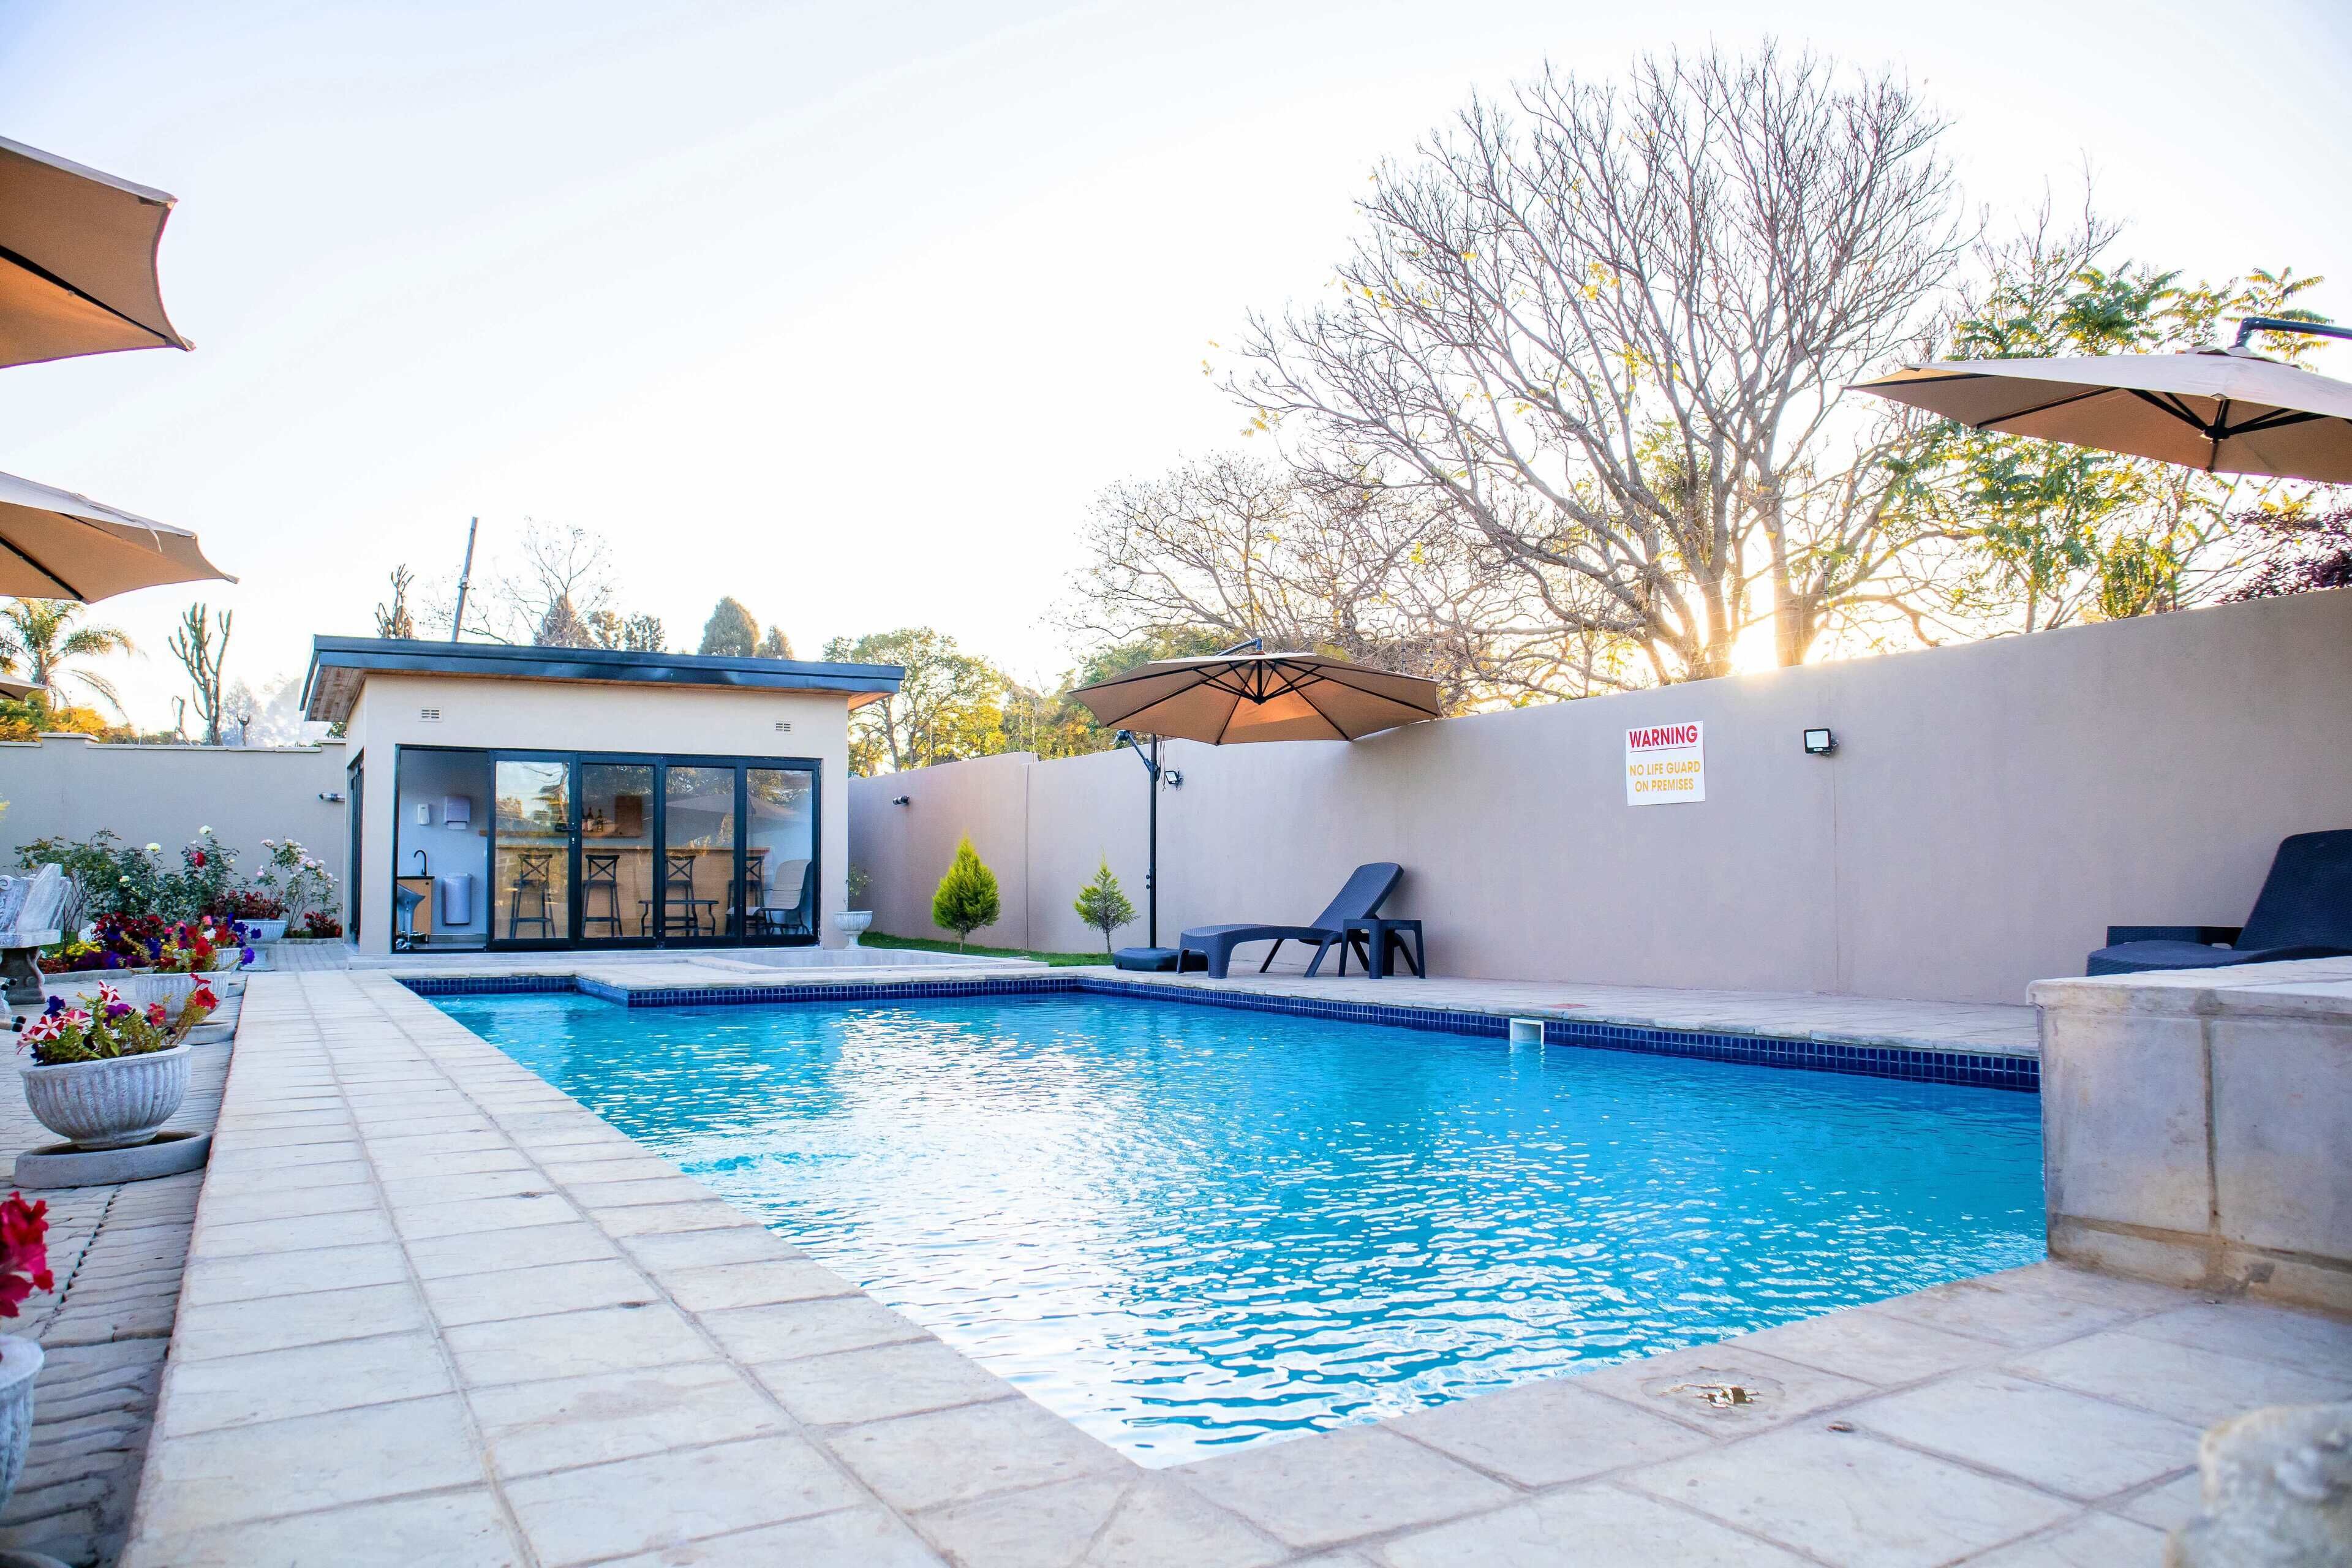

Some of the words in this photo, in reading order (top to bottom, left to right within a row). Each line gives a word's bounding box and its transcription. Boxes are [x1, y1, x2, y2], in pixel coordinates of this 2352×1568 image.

[1629, 725, 1698, 748] WARNING
[1629, 764, 1645, 777] NO
[1647, 763, 1664, 775] LIFE
[1666, 761, 1701, 774] GUARD
[1635, 780, 1649, 793] ON
[1651, 778, 1694, 791] PREMISES
